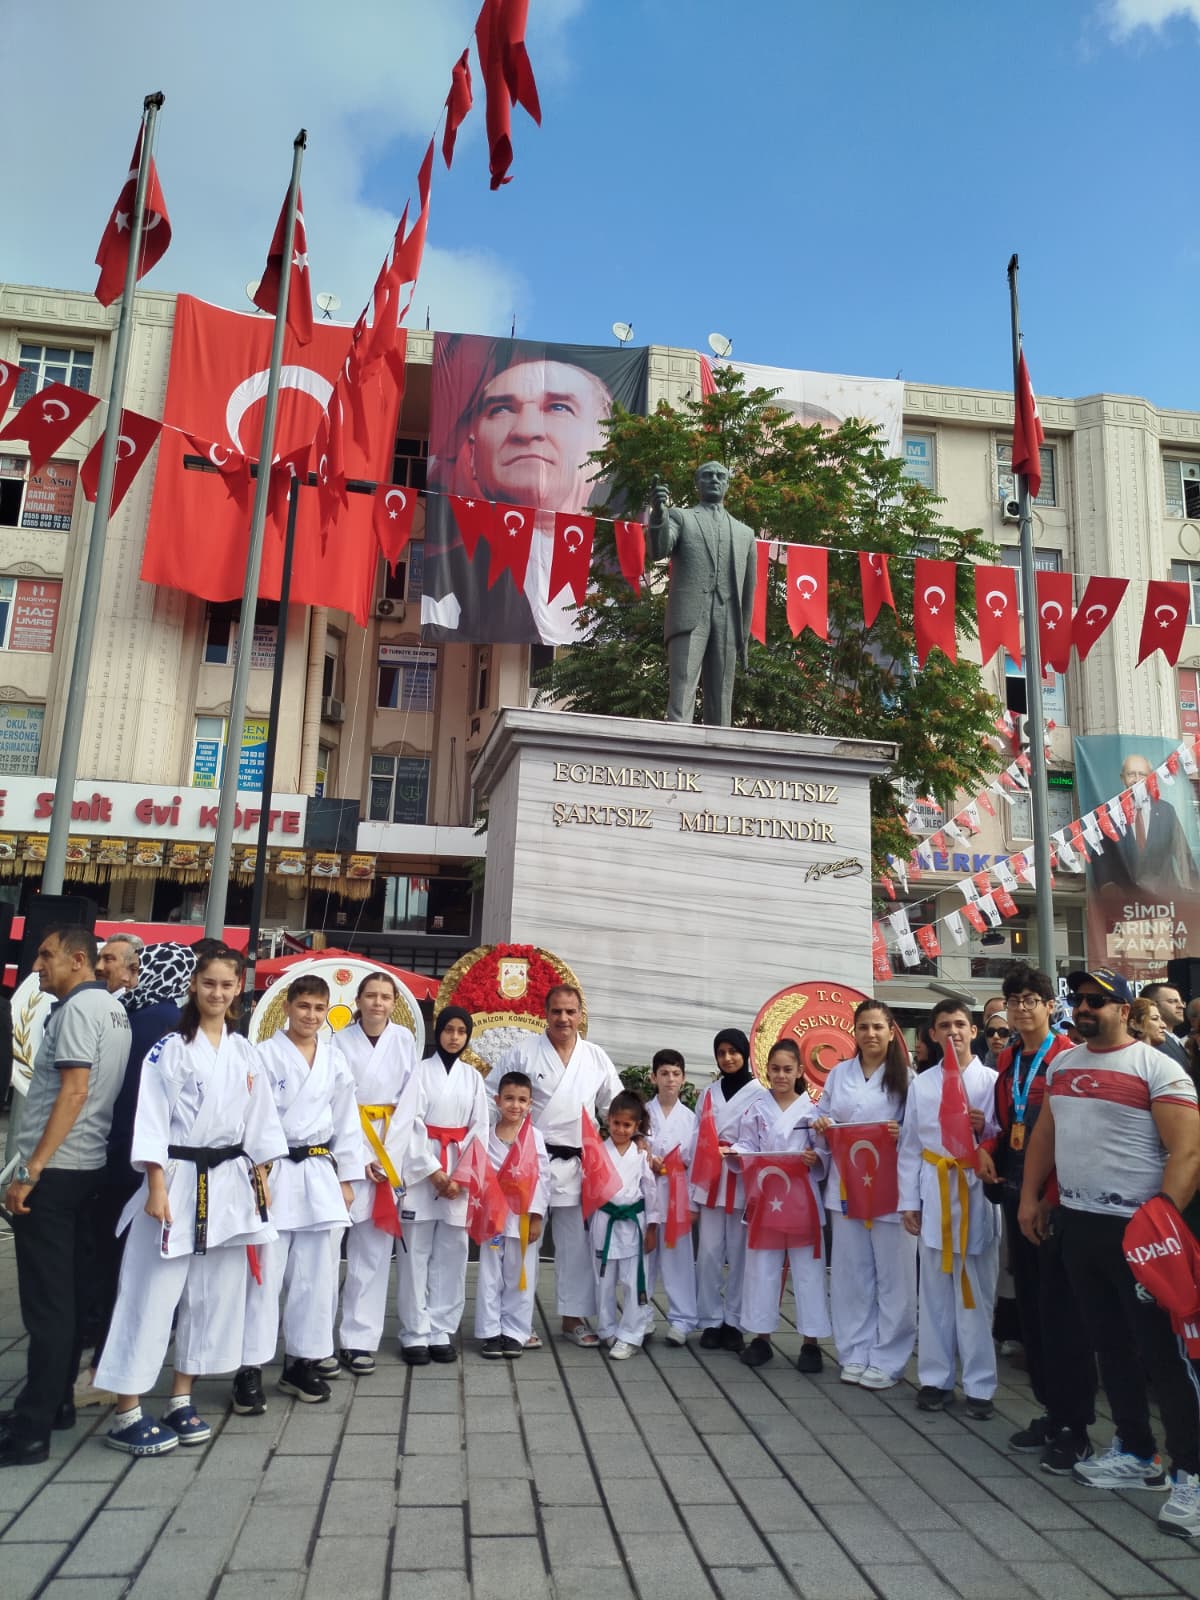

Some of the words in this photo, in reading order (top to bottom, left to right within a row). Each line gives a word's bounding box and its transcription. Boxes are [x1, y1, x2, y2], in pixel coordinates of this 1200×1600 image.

[18, 606, 54, 618] HAC
[16, 617, 52, 627] UMRE
[1043, 687, 1055, 695] HP
[6, 720, 27, 729] OKUL
[553, 762, 703, 793] EGEMENLİK
[731, 776, 840, 805] KAYITSIZ
[135, 795, 183, 827] Evi
[552, 802, 654, 829] ŞARTSIZ
[1123, 901, 1176, 920] ŞİMDİ
[1112, 920, 1188, 935] ARINMA
[473, 1014, 504, 1028] ARNİZON
